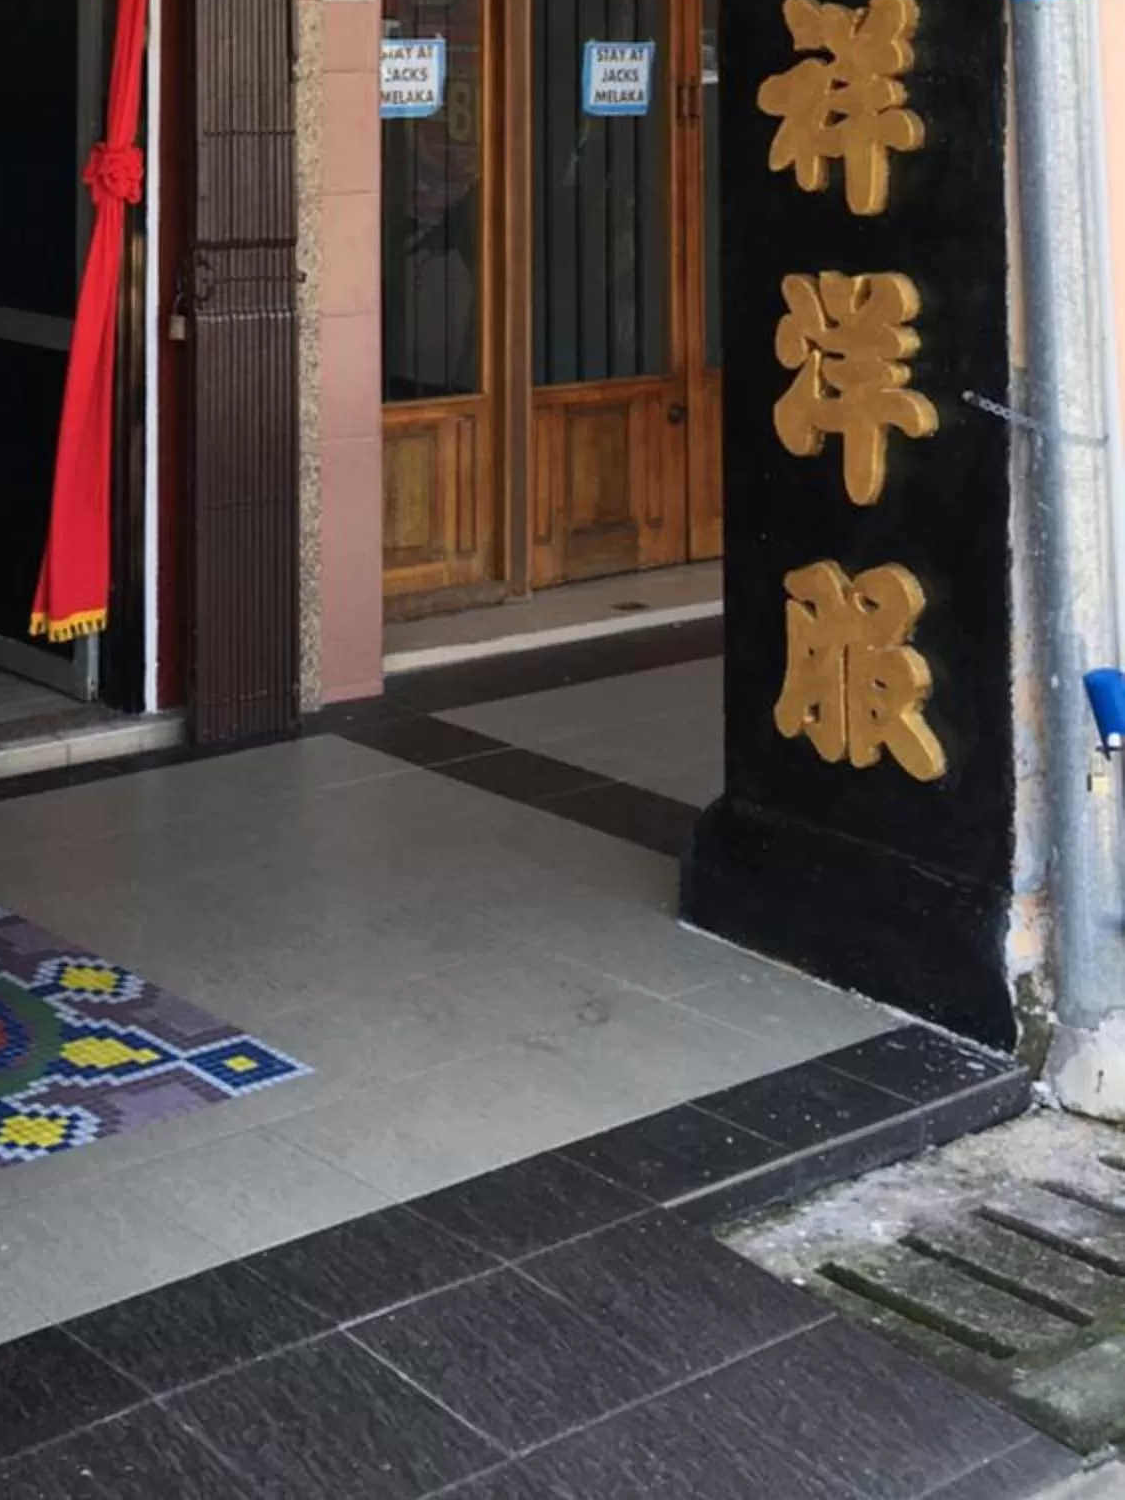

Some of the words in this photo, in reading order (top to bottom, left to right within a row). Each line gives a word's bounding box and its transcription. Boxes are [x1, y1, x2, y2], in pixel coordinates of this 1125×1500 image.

[596, 48, 628, 62] STAY
[629, 48, 644, 62] AT
[602, 68, 639, 83] JACKS
[594, 89, 644, 103] MELAKA
